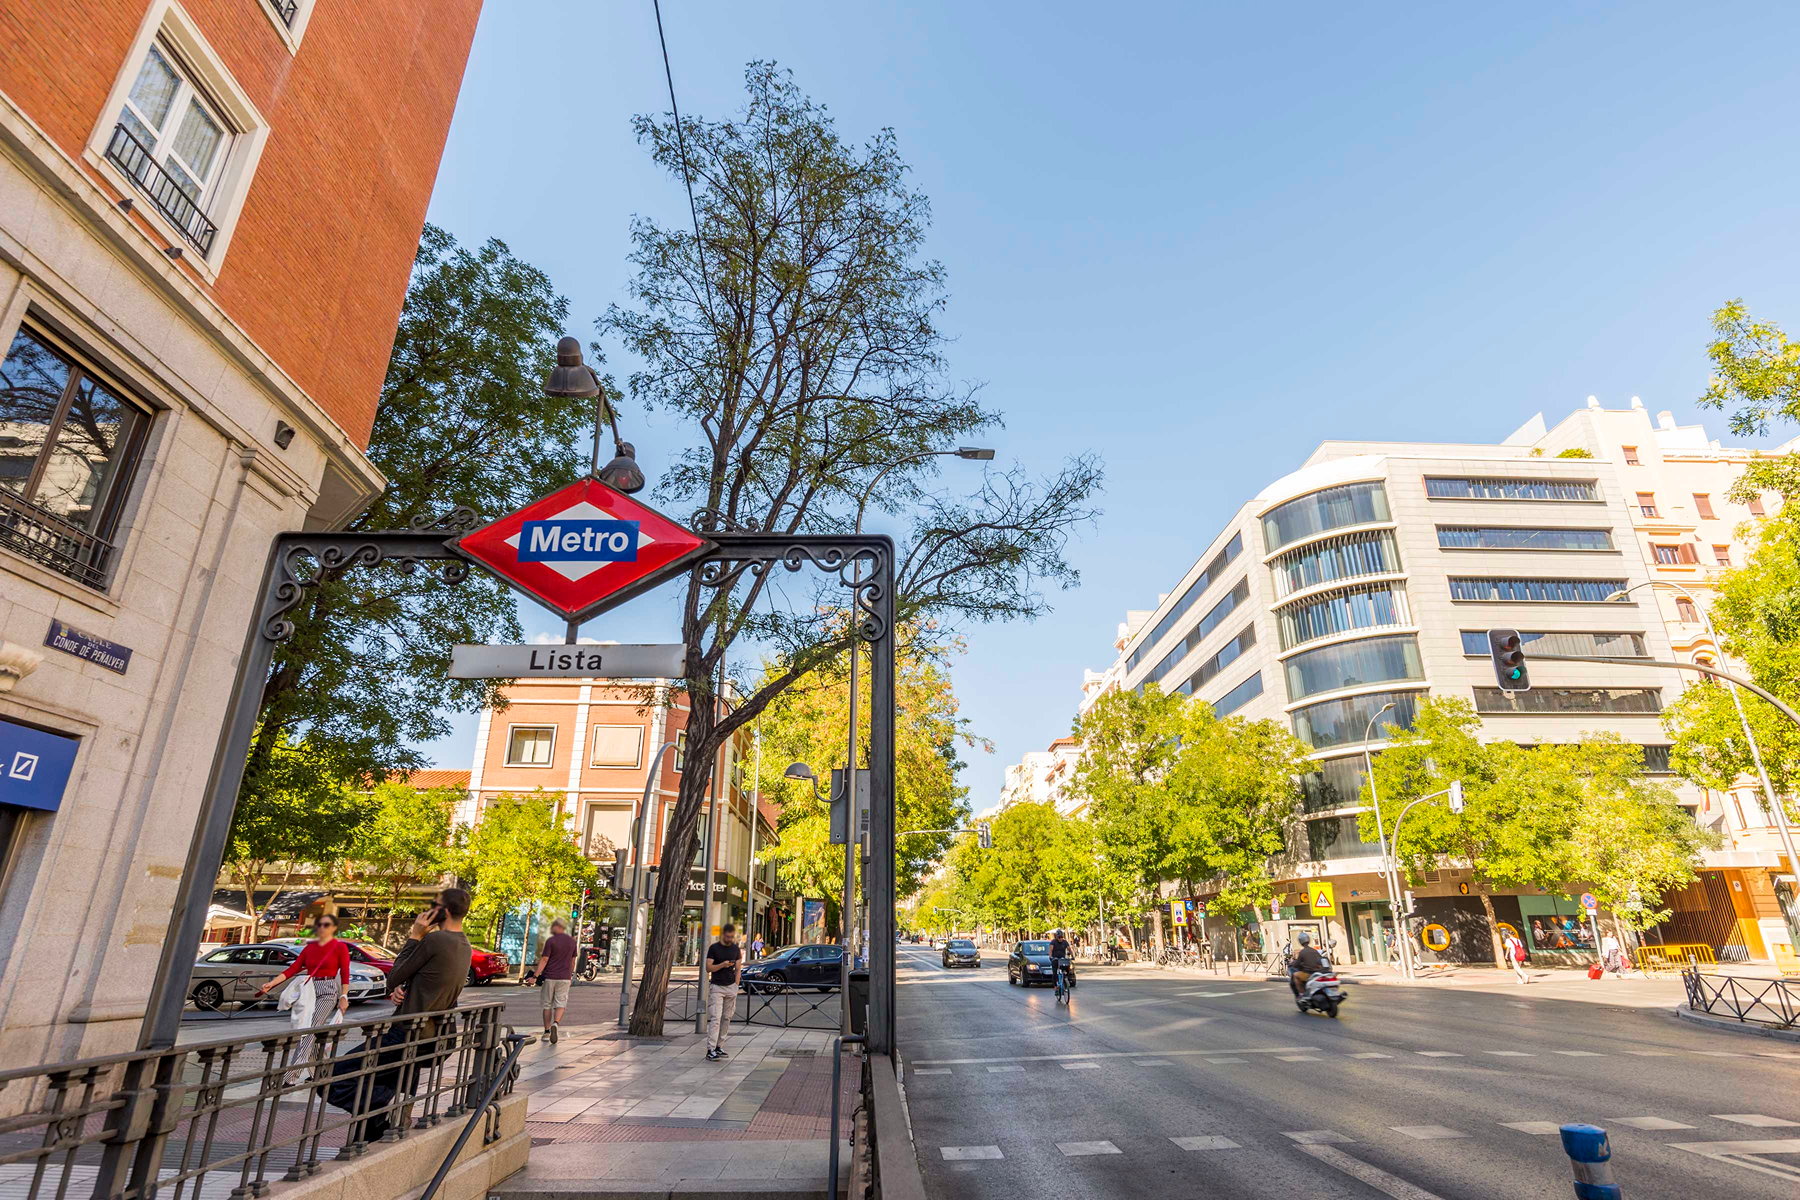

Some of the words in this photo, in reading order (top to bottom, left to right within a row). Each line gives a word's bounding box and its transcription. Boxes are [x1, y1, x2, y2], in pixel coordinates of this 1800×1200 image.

[529, 526, 629, 553] Metro
[53, 635, 80, 653] CONDE
[79, 645, 90, 658] DE
[90, 649, 125, 670] PEÑALVER
[87, 641, 100, 650] DEL
[529, 649, 603, 671] Lista
